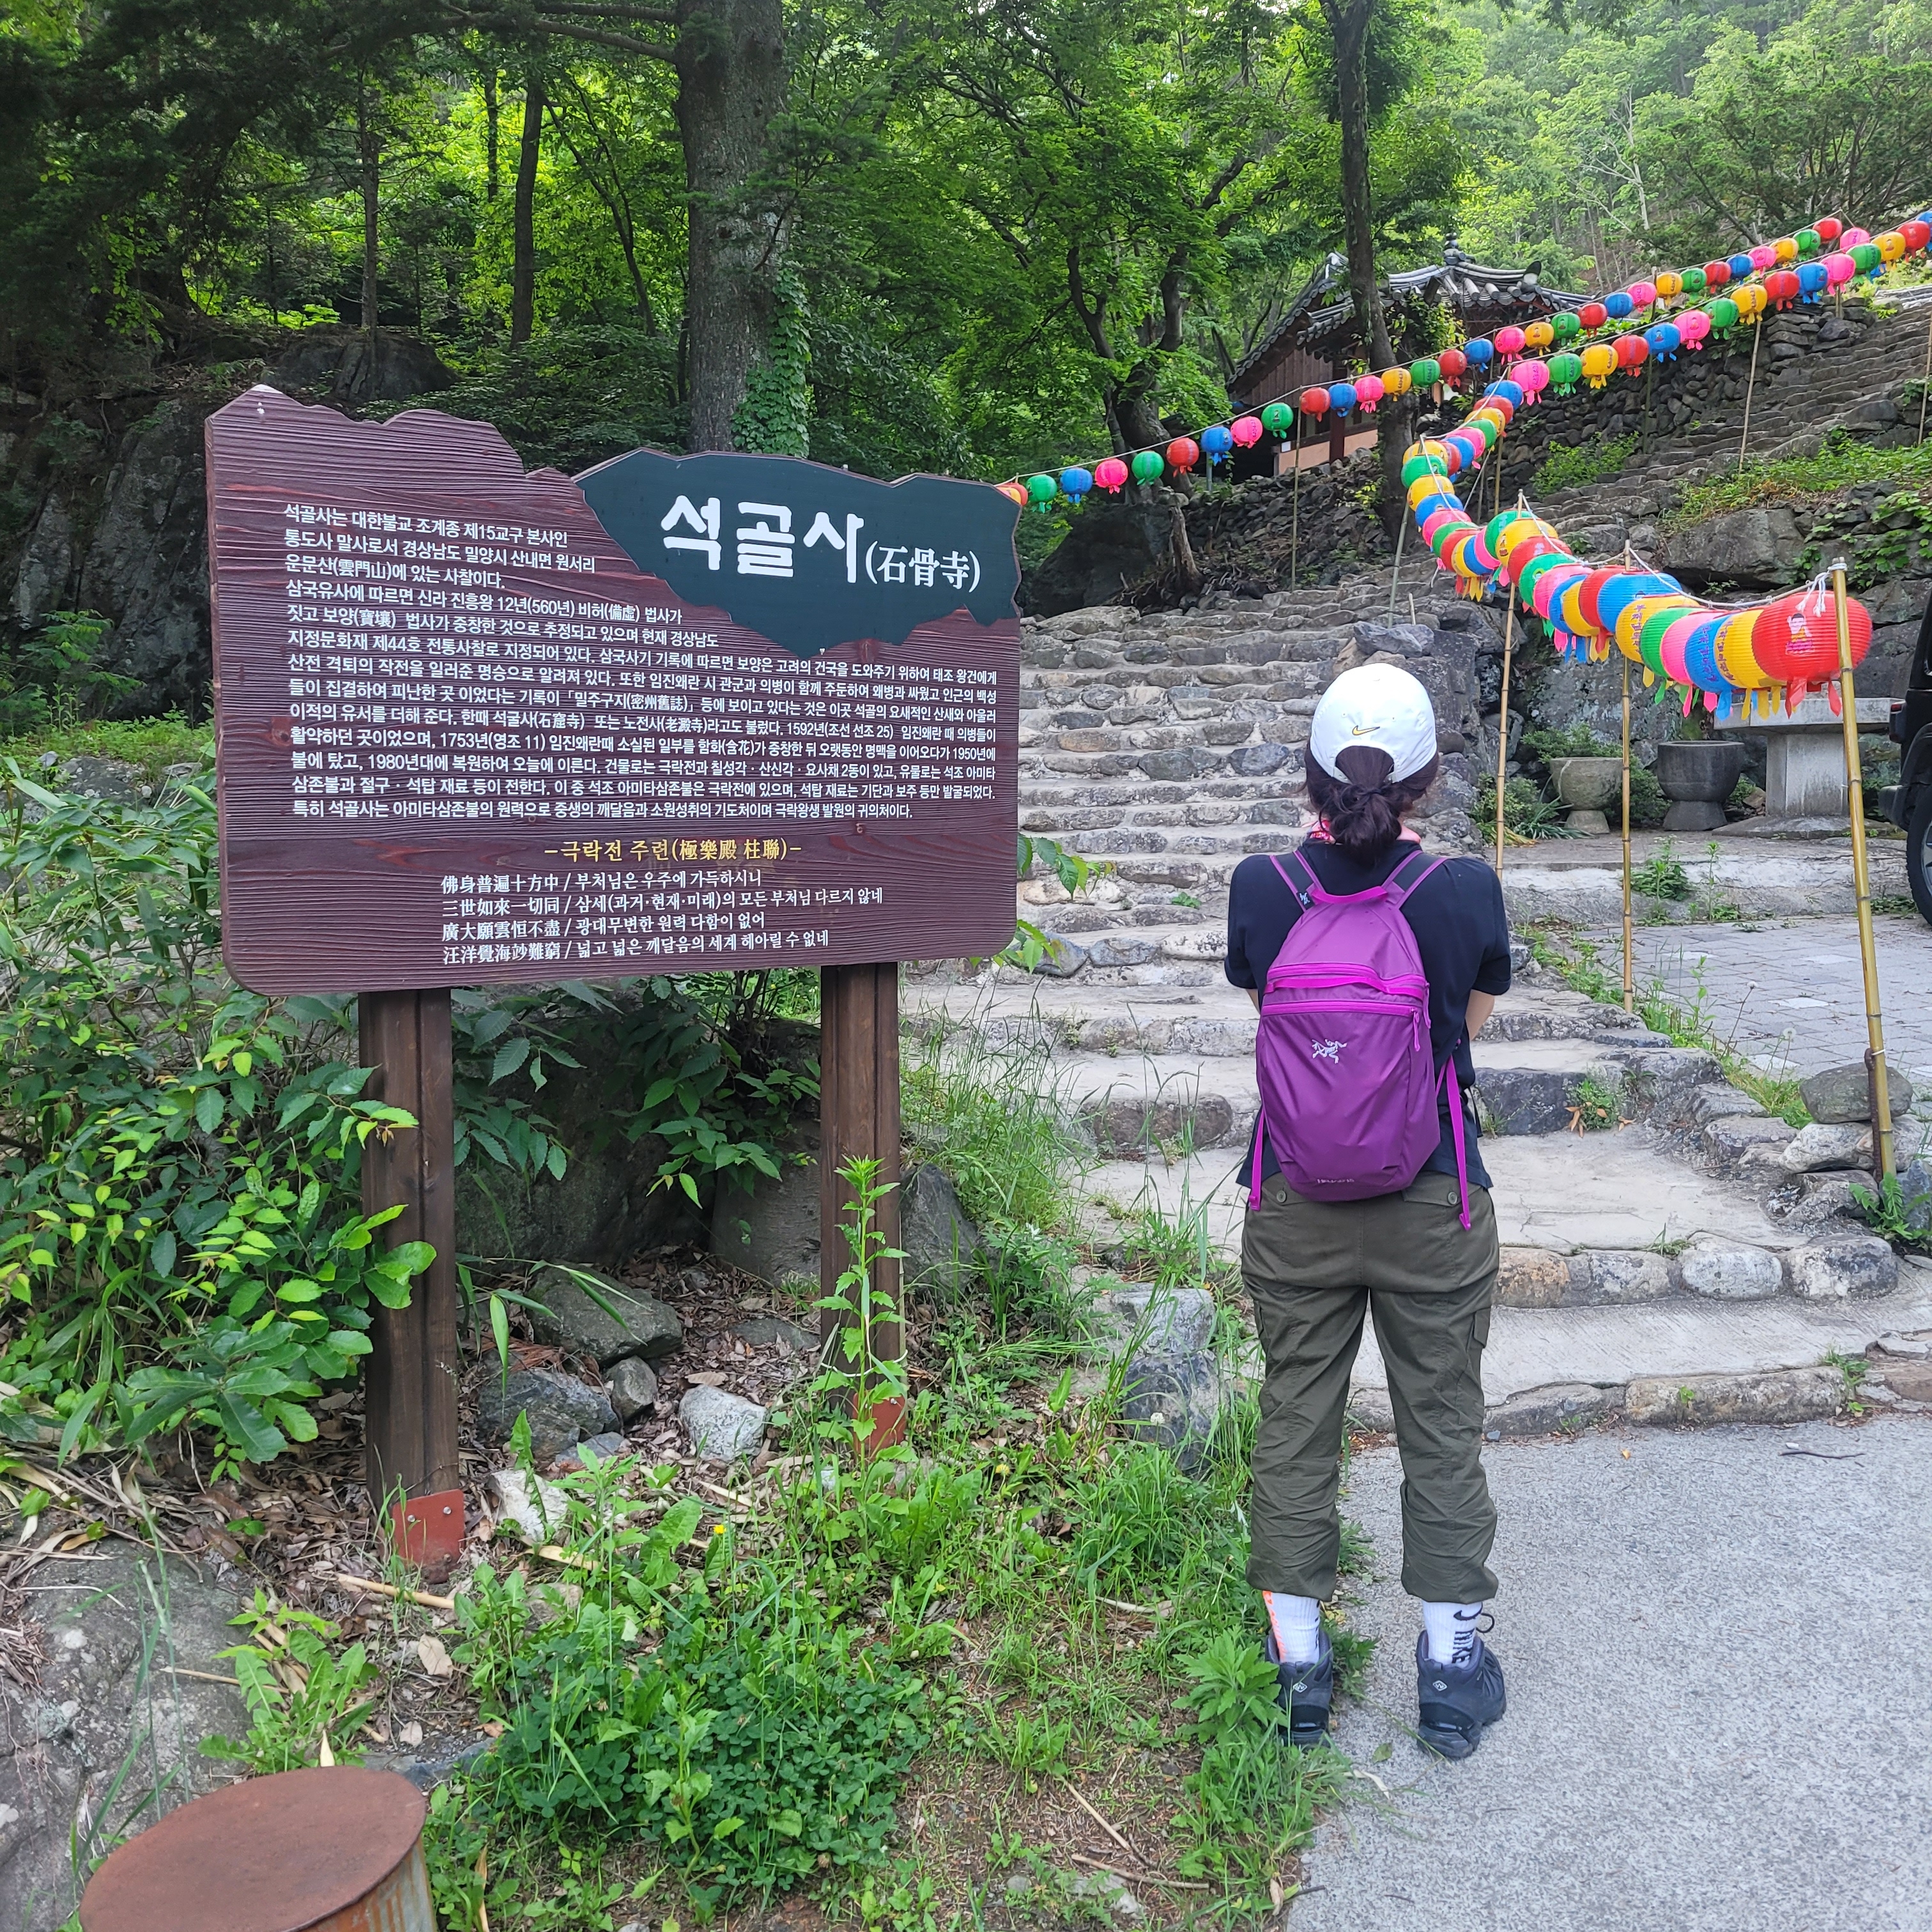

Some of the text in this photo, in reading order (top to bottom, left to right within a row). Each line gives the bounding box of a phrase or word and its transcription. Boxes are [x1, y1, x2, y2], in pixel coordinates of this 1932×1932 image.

[284, 505, 568, 548] 석골사는 대한불교 조계종 제15교구 본사인
[661, 494, 981, 593] 석골사 (石骨寺)
[284, 528, 595, 572] 통도사 말사로서 경상남도 밀양시 산내면 원서리
[286, 553, 505, 589] 운문산(雲門山)에 있는 사찰이다.
[286, 579, 365, 602] 삼국유사에
[368, 586, 414, 606] 따르면
[417, 589, 448, 608] 신라
[450, 592, 494, 611] 진흥왕
[497, 596, 575, 618] 12년(560년)
[645, 608, 682, 625] 법사가
[286, 604, 319, 622] 짓고
[405, 612, 450, 632] 법사가
[452, 616, 497, 634] 중창한
[499, 618, 540, 636] 것으로
[542, 622, 597, 641] 추정되고
[600, 625, 638, 644] 있으며
[641, 628, 667, 645] 현재
[670, 631, 719, 648] 경상남도
[288, 629, 997, 686] 지정문화재 제44호 전통사찰로 지정되어 있다. 삼국사기 기록에 따르면 보양은 고려의 건국을 도와주기 위하여 태조 왕건에게
[289, 702, 337, 721] 이적의
[341, 704, 388, 723] 유서를
[390, 705, 420, 724] 더해
[423, 708, 457, 725] 준다.
[461, 709, 489, 726] 한때
[594, 714, 620, 730] 또는
[746, 720, 784, 736] 불렀다.
[786, 722, 850, 738] 1592년(조선
[853, 724, 875, 739] 선조
[876, 724, 894, 739] 25)
[901, 725, 942, 740] 임진왜란
[944, 727, 954, 740] 때
[956, 727, 996, 742] 의병들이
[291, 726, 996, 761] 활약하던 곳이었으며, 1753년(영조 11) 임진왜란때 소실된 일부를 함화(含花)가 중창한 뒤 오랫동안 명맥을 이어오다가 1950년에
[291, 751, 996, 780] 불에 탔고, 1980년대에 복원하여 오늘에 이른다. 건물로는 극락전과 칠성각 산신각 요사채 2동이 있고, 유물로는 석조 아미타
[292, 776, 995, 799] 삼존불과 절구 석탑 재료 등이 전한다. 이 중 석조 아미타삼존불은 극락전에 있으며, 석탑 재료는 기단과 보주 등만 발굴되었다.
[294, 800, 913, 818] 특히 석골사는 아미타삼존불의 원력으로 중생의 깨달음과 소원성취의 기도처이며 극락왕생 발원의 귀의처이다.
[630, 839, 737, 861] 주련(極樂殿
[574, 872, 638, 891] 부처님은
[641, 871, 686, 888] 우주에
[691, 870, 760, 887] 가득하시니
[442, 896, 560, 917] 三世如來一切同
[739, 891, 768, 907] 모든
[770, 889, 811, 907] 부처님
[815, 888, 854, 905] 다르지
[857, 887, 882, 905] 않네
[575, 915, 655, 936] 광대무변한
[659, 915, 686, 932] 원력
[691, 914, 733, 931] 다함이
[739, 912, 764, 930] 없어
[577, 940, 608, 958] 넓고
[611, 938, 643, 956] 넓은
[646, 935, 705, 955] 깨달음의
[709, 933, 737, 951] 세계
[742, 932, 781, 950] 헤아릴
[785, 931, 800, 948] 수
[802, 930, 829, 947] 없네
